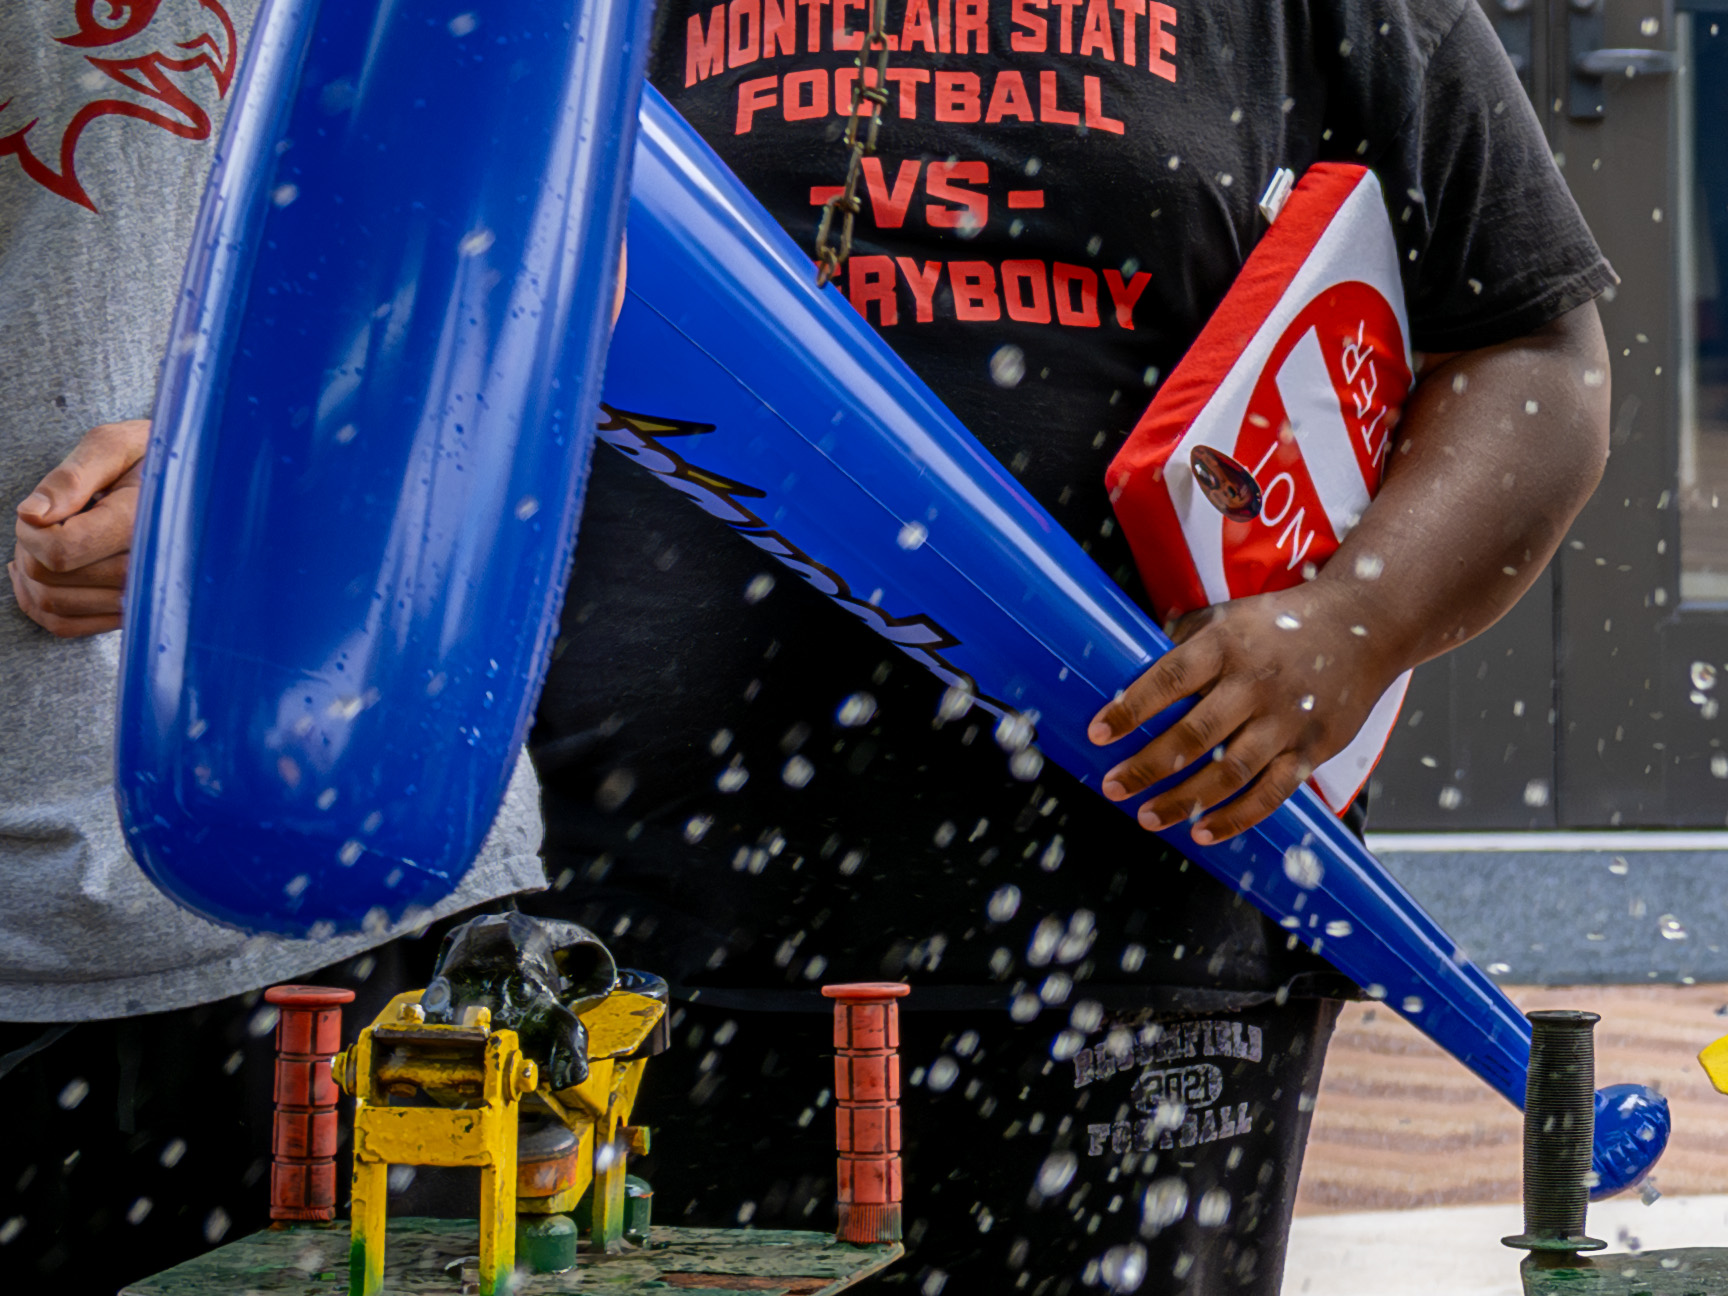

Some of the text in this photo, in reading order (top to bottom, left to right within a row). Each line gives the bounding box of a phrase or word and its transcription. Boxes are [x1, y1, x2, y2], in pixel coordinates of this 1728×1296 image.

[735, 67, 1125, 135] FOOTBALL
[816, 255, 1153, 330] RYBODY
[1341, 319, 1389, 484] NTER
[1142, 1066, 1214, 1106] 2021
